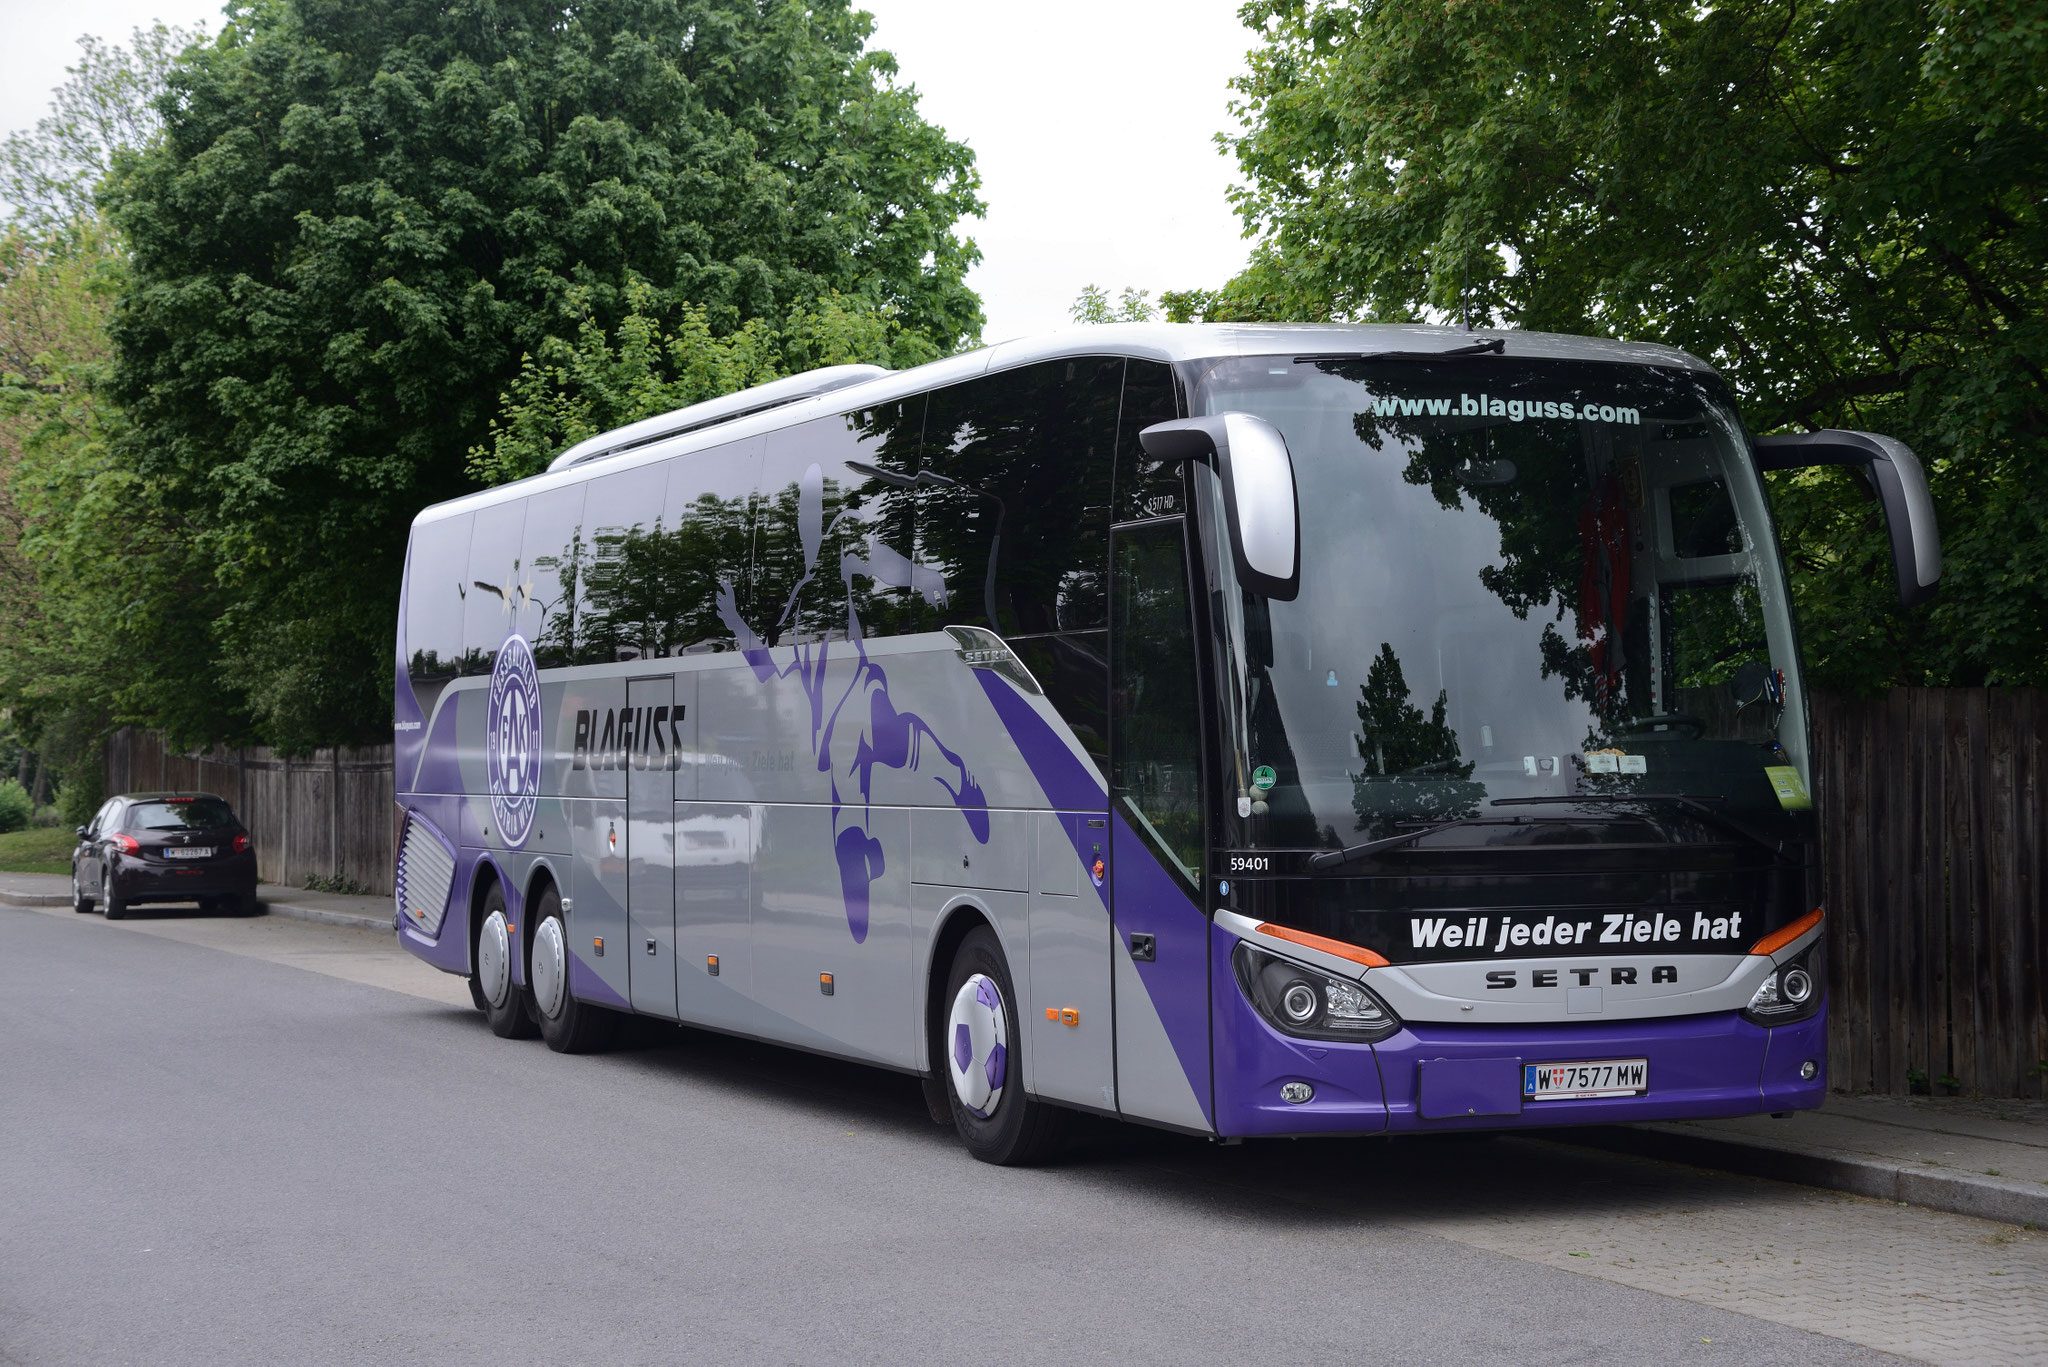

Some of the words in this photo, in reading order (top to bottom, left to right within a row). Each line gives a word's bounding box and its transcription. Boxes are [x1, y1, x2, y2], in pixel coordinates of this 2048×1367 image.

[1373, 394, 1640, 425] www.blaguss.com
[1164, 495, 1174, 509] HD
[965, 649, 1009, 662] SETRA
[493, 645, 537, 709] FUSSBALLKLUB
[572, 705, 686, 772] BLAGUSS
[778, 749, 795, 772] hat
[1260, 767, 1268, 778] 4
[493, 779, 518, 835] AUSTRIA
[519, 779, 535, 829] WIEN
[1231, 857, 1269, 871] 59401
[1411, 916, 1488, 948] Weil
[1494, 916, 1592, 952] jeder
[1600, 912, 1681, 943] Ziele
[1691, 911, 1742, 940] hat
[1485, 965, 1678, 990] SETRA
[1538, 1069, 1551, 1090] W
[1567, 1066, 1613, 1088] 7577
[1617, 1065, 1643, 1086] MW
